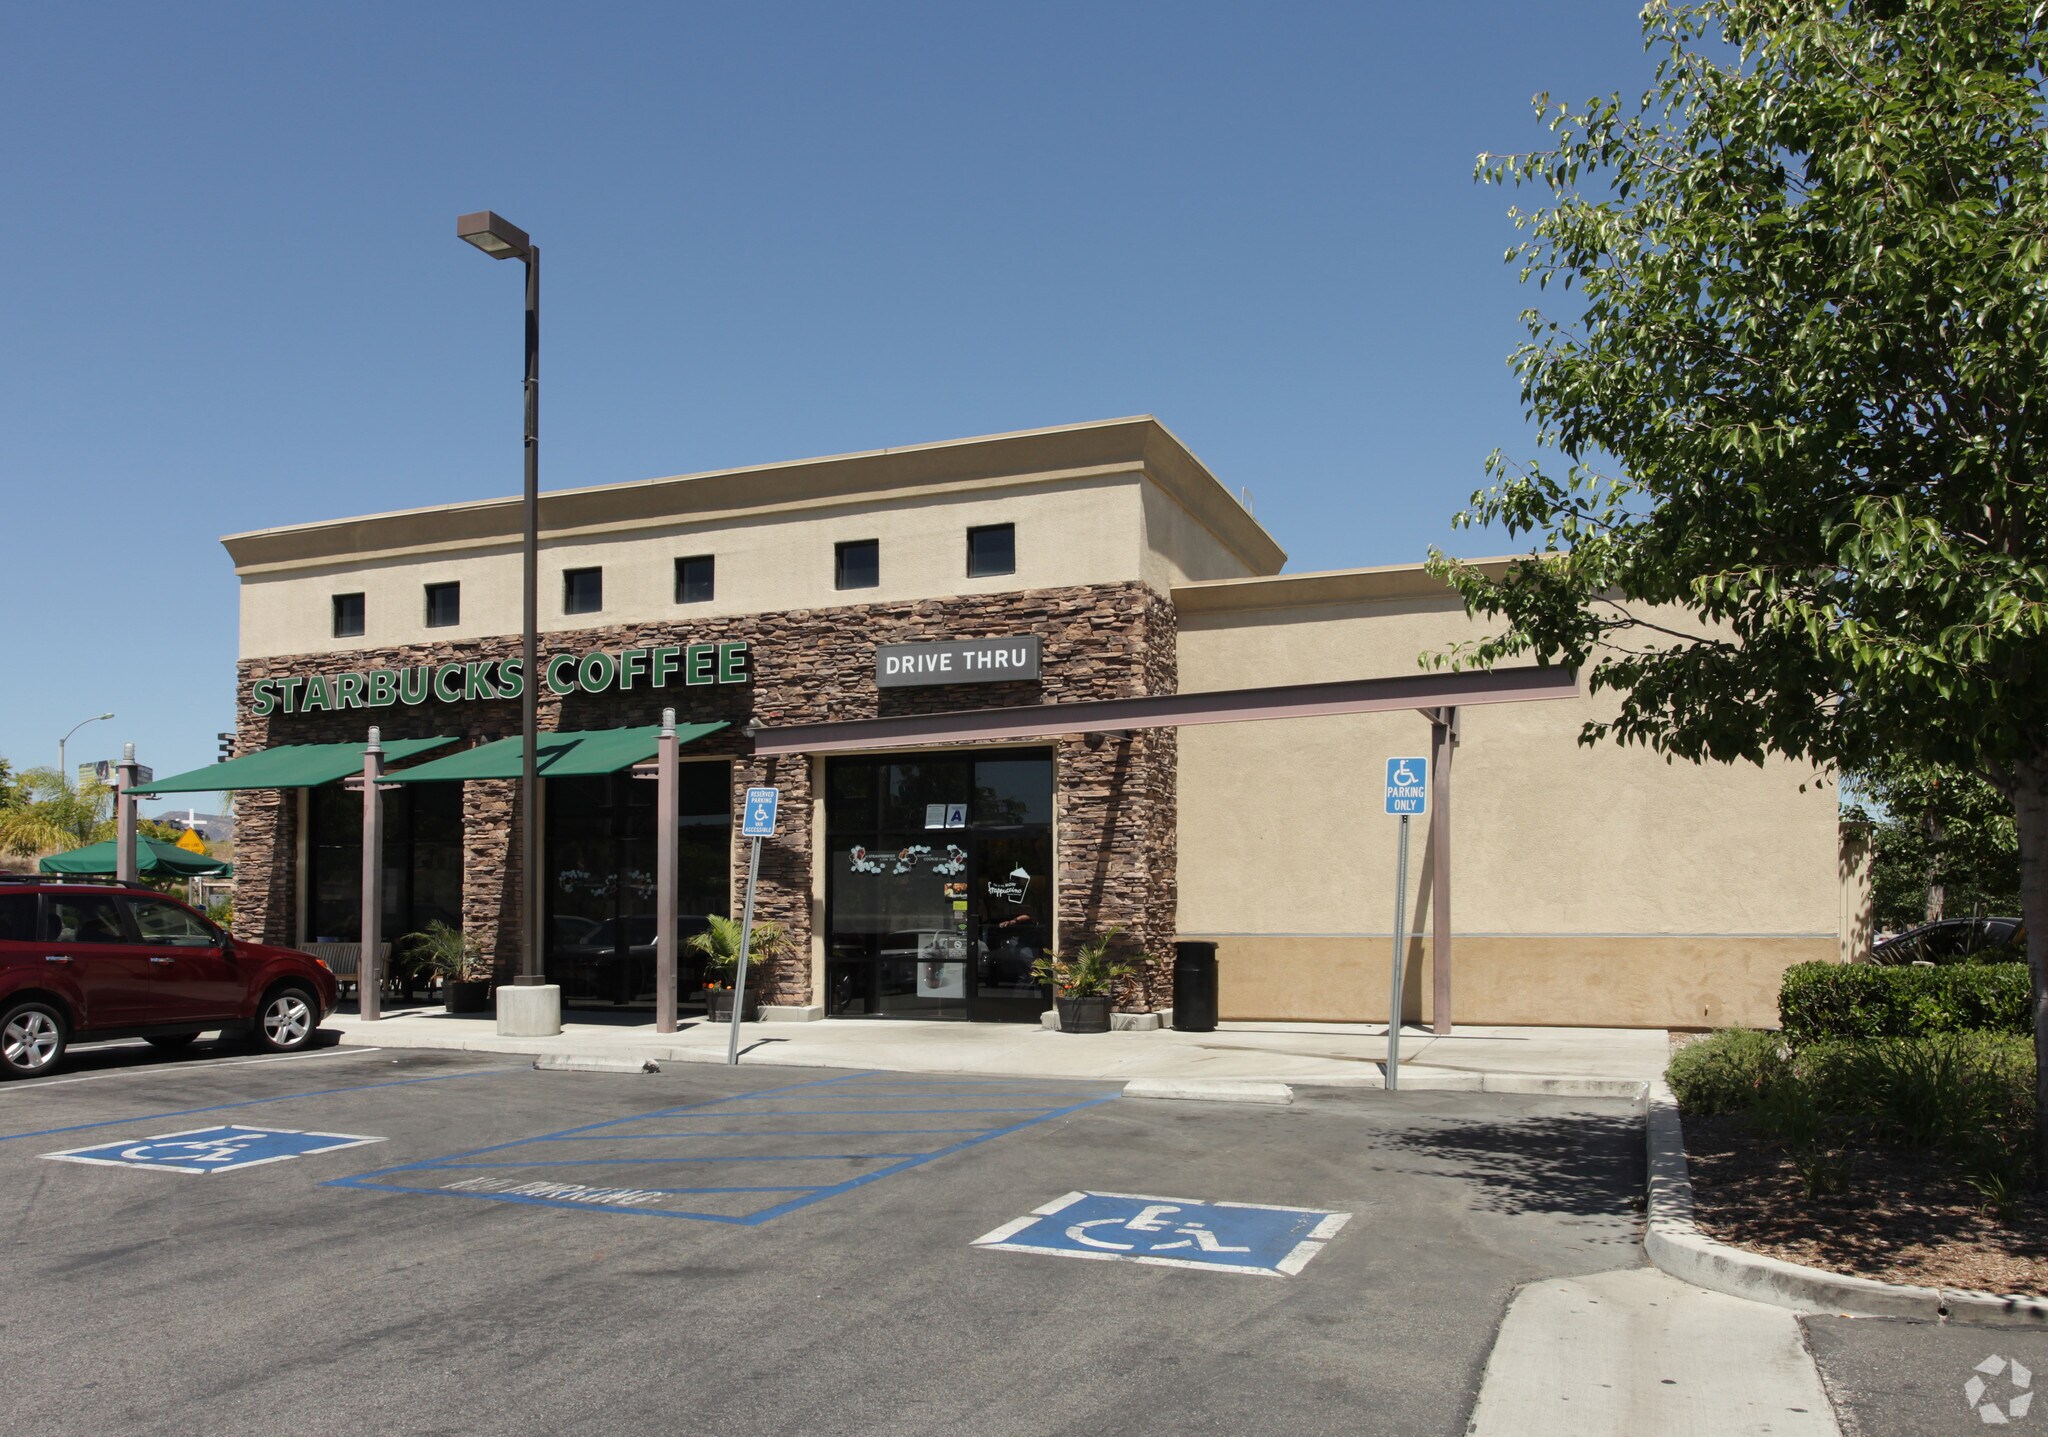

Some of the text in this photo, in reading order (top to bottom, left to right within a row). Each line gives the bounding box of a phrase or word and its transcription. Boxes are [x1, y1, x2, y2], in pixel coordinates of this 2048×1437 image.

[886, 648, 1026, 674] DRIVE THRU
[252, 642, 748, 716] STARBUCKS COFFEE
[1387, 786, 1424, 798] PARKING
[1394, 799, 1417, 811] ONLY
[950, 810, 962, 821] A
